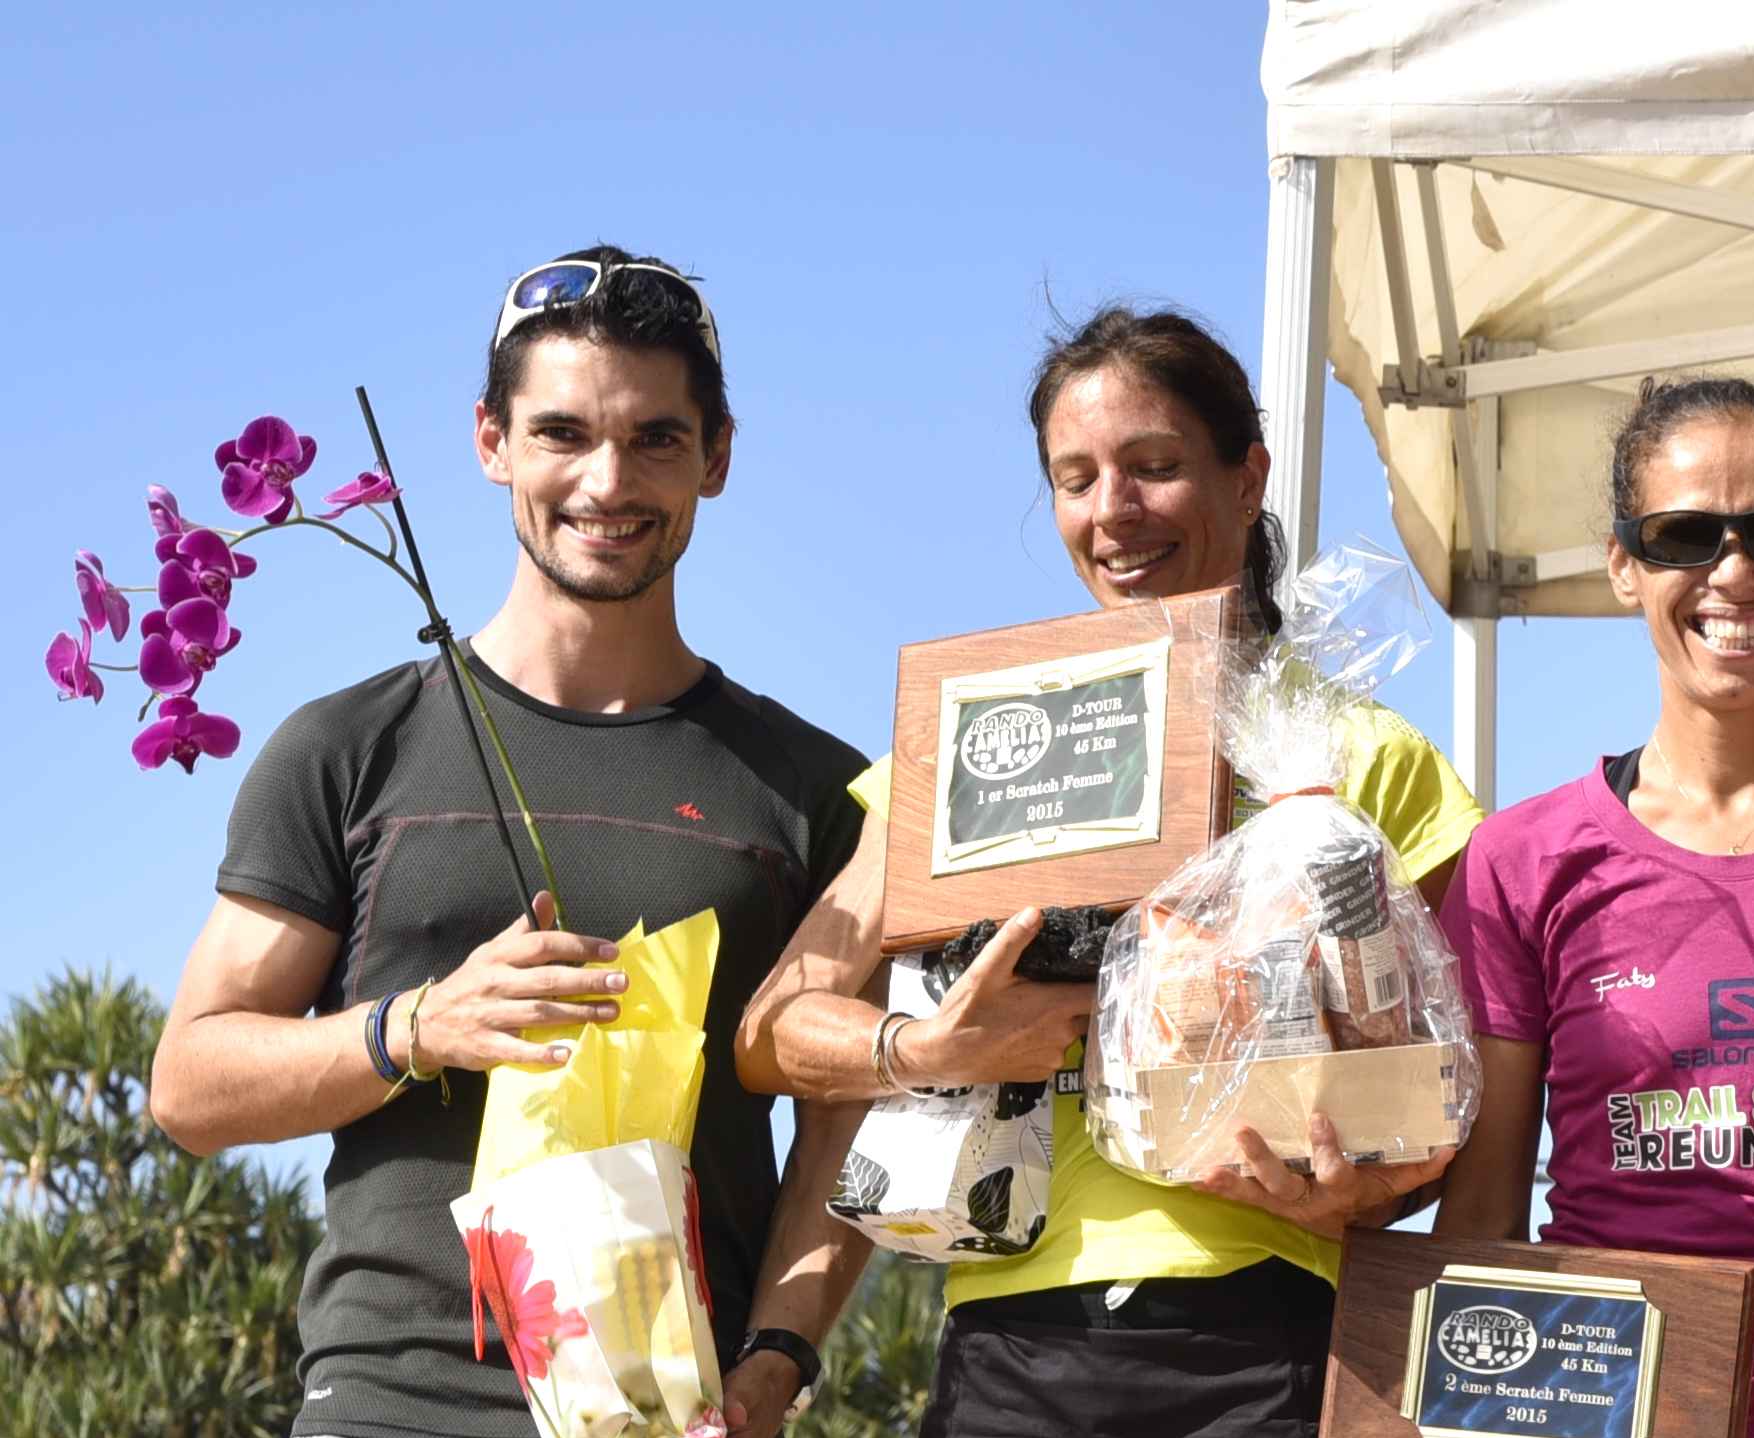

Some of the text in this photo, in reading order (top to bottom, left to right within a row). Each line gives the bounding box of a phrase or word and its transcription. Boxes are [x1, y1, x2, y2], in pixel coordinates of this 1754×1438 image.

[1072, 698, 1123, 717] D-TOUR
[971, 710, 1044, 735] RANDO
[1055, 724, 1068, 737] 10
[1096, 713, 1138, 730] Edition
[1074, 736, 1117, 754] 45 Km
[978, 791, 985, 805] 1
[1006, 779, 1059, 799] Scratch
[1063, 772, 1113, 790] Femme
[1027, 802, 1064, 822] 2015
[1590, 967, 1655, 1002] Faty
[1632, 1084, 1747, 1132] TRAIL
[1608, 1093, 1638, 1171] TEAM
[1450, 1311, 1533, 1332] RANDO
[1560, 1324, 1617, 1339] D-TOUR
[1441, 1325, 1536, 1349] CAMELIAS
[1541, 1338, 1632, 1356] 10 ème Edition
[1560, 1358, 1608, 1374] 45 Km
[1445, 1373, 1614, 1406] 2 ème Scratch Femme
[1506, 1406, 1548, 1424] 2015
